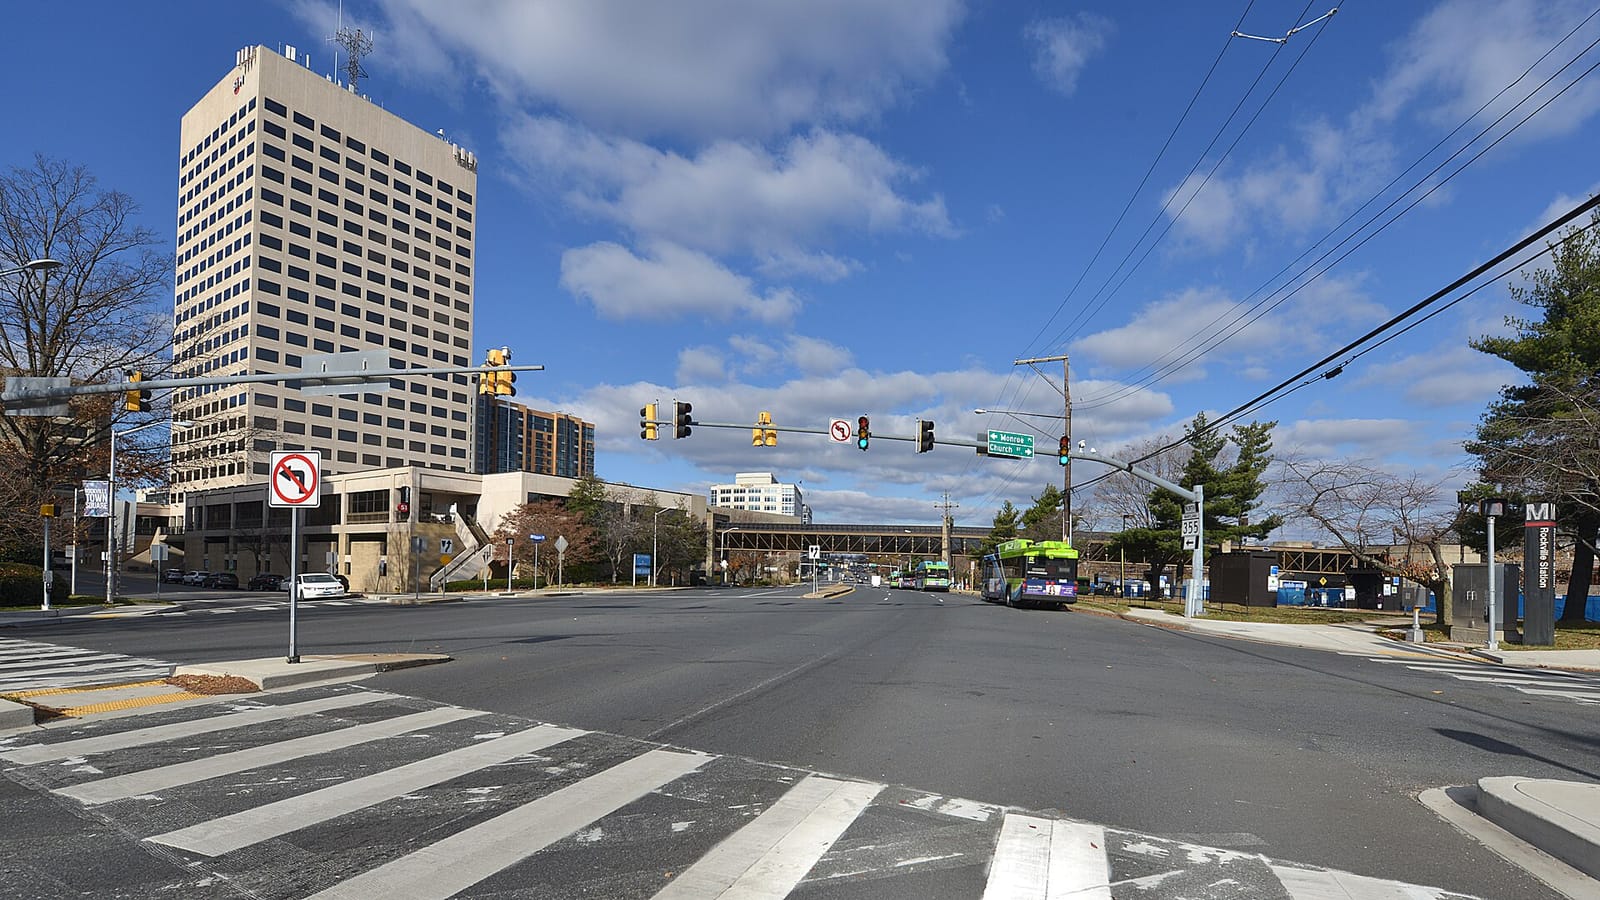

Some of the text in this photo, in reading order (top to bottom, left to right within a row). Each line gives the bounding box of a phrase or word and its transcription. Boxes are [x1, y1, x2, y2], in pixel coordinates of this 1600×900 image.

[1000, 434, 1024, 443] Monroe
[990, 444, 1013, 453] Church
[85, 493, 107, 503] TOWN
[1526, 503, 1549, 520] M
[1183, 521, 1198, 534] 355
[1539, 527, 1549, 588] Rockville Station
